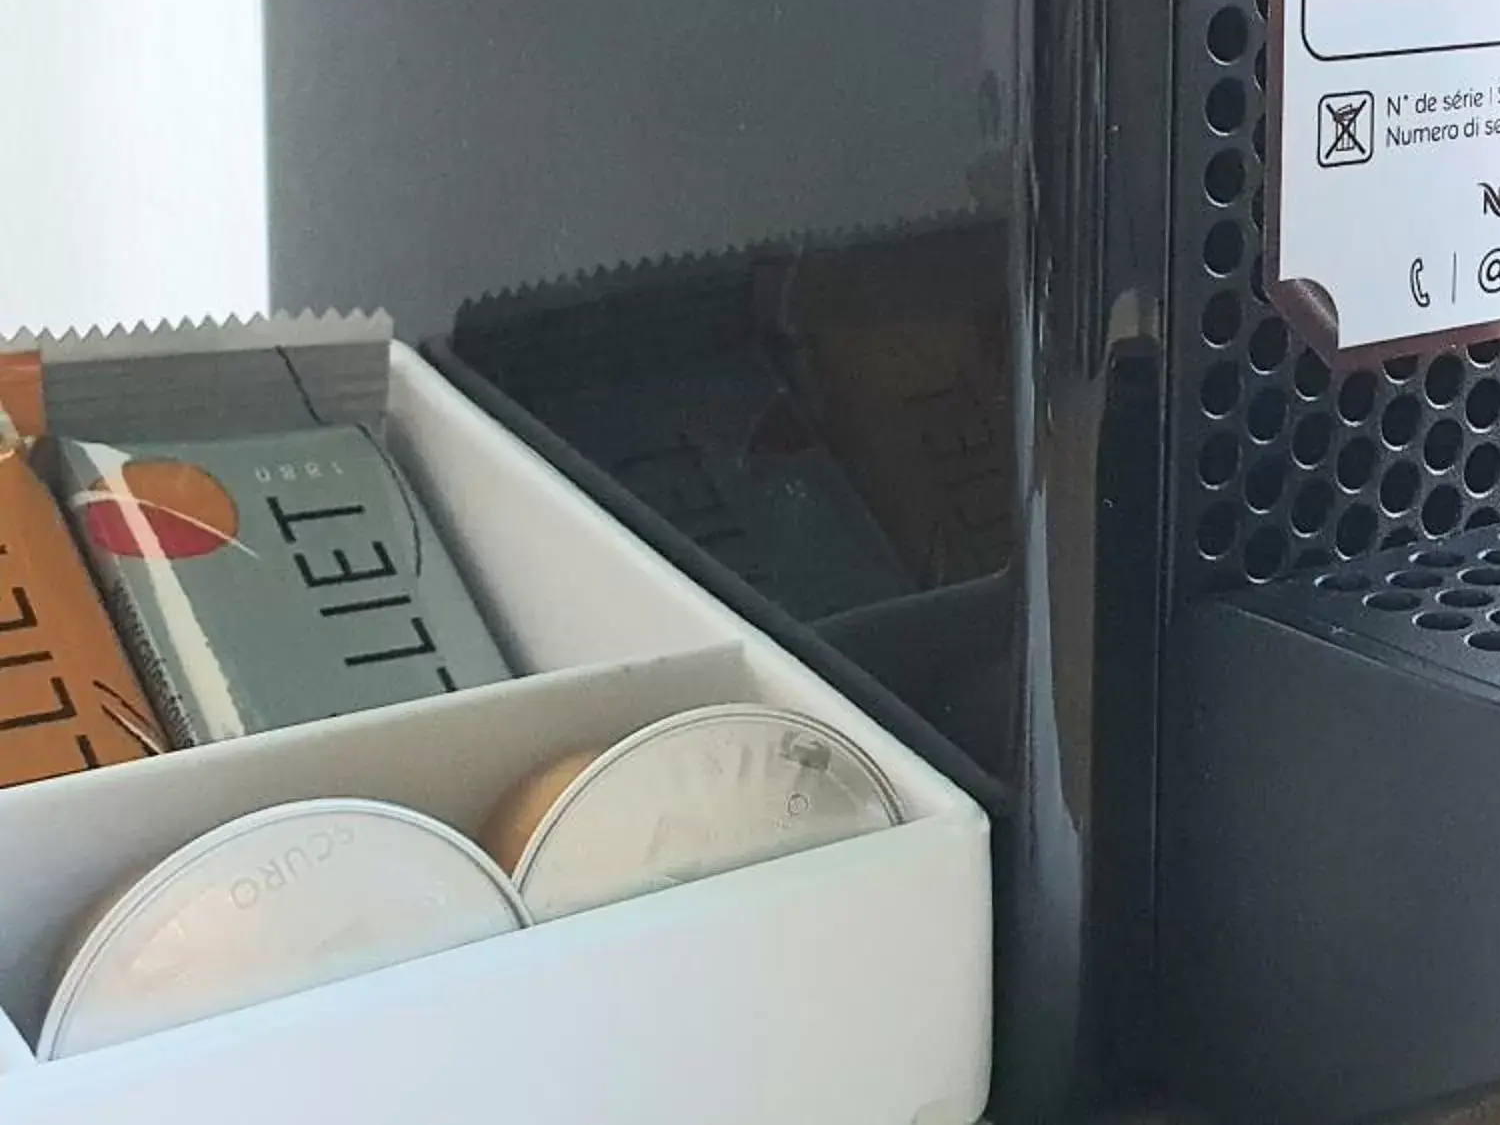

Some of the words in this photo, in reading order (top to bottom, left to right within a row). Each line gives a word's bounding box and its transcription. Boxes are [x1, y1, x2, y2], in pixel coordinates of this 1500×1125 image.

[1415, 92, 1438, 114] de
[1442, 87, 1484, 112] série
[1385, 122, 1460, 148] Numero
[1463, 116, 1479, 138] di
